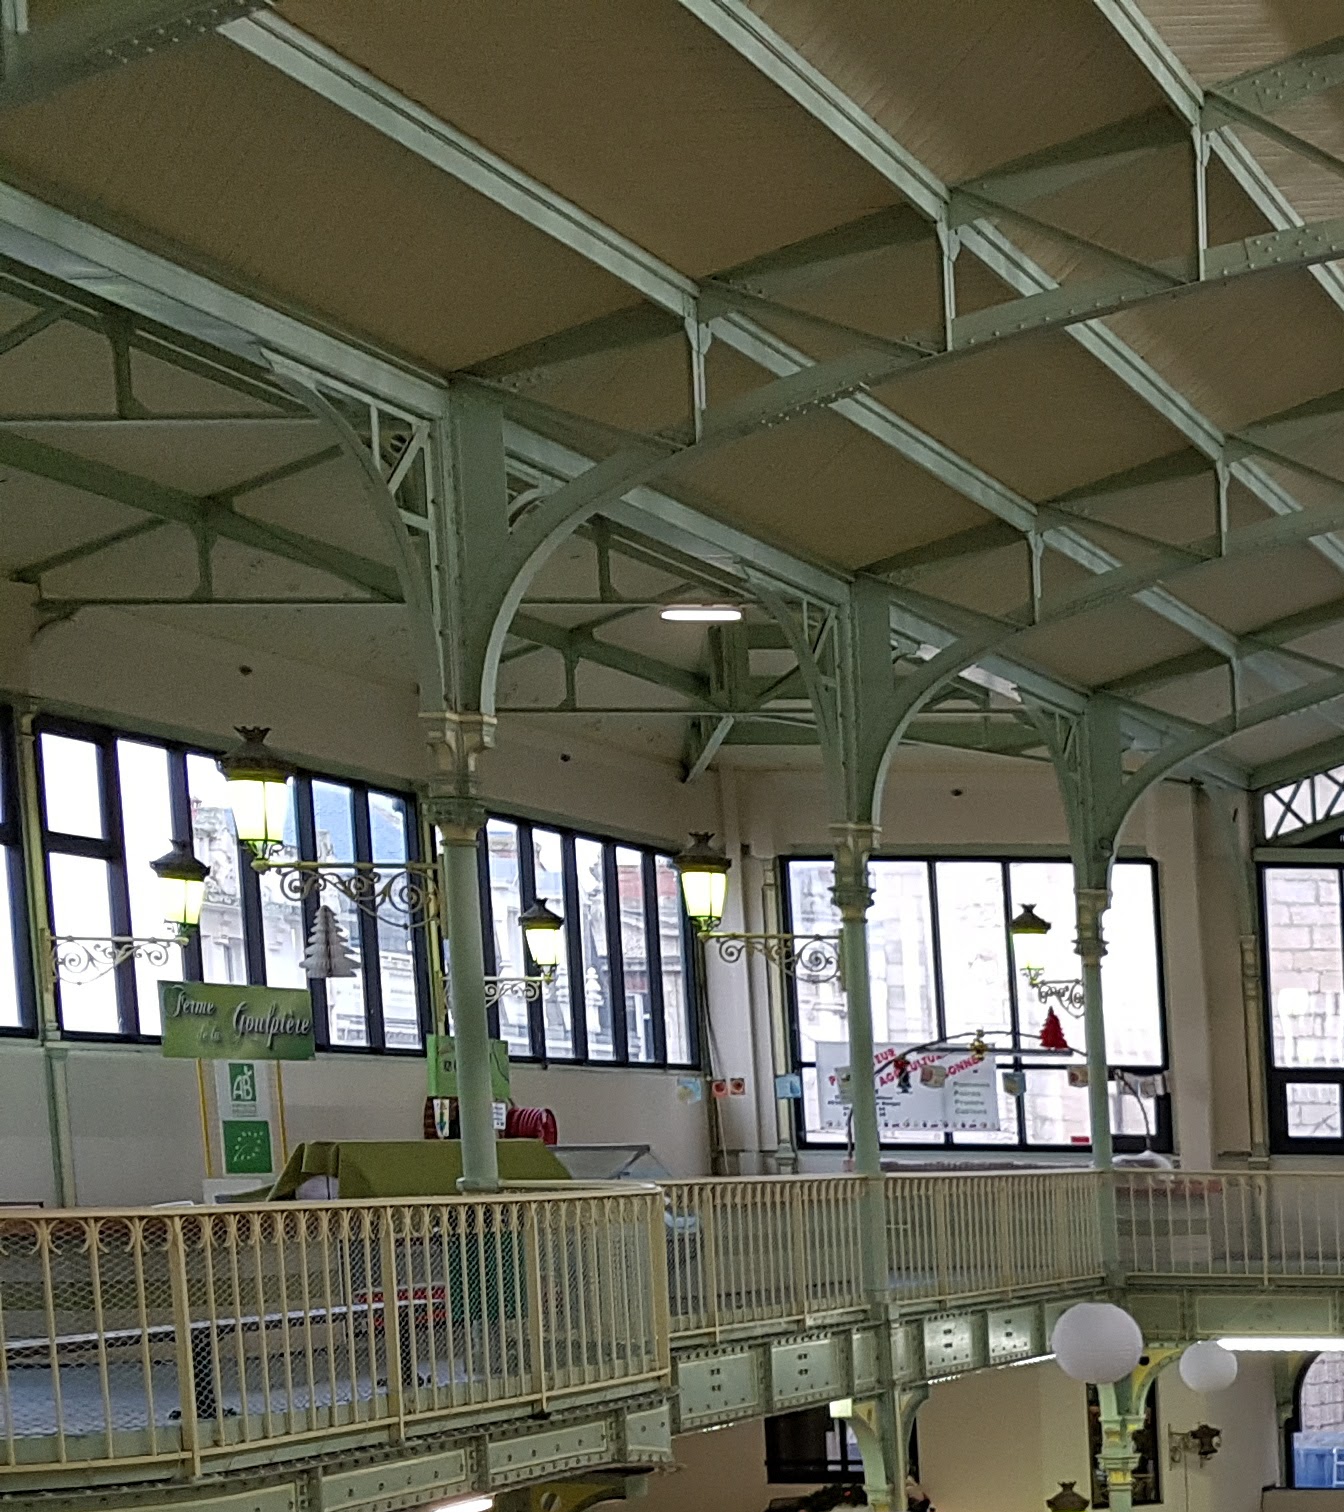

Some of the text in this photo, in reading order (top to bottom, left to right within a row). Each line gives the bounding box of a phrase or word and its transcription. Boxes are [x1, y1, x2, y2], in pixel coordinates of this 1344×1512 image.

[171, 984, 216, 1017] Ferme
[232, 1000, 311, 1049] Goulpière
[232, 1074, 253, 1100] AB
